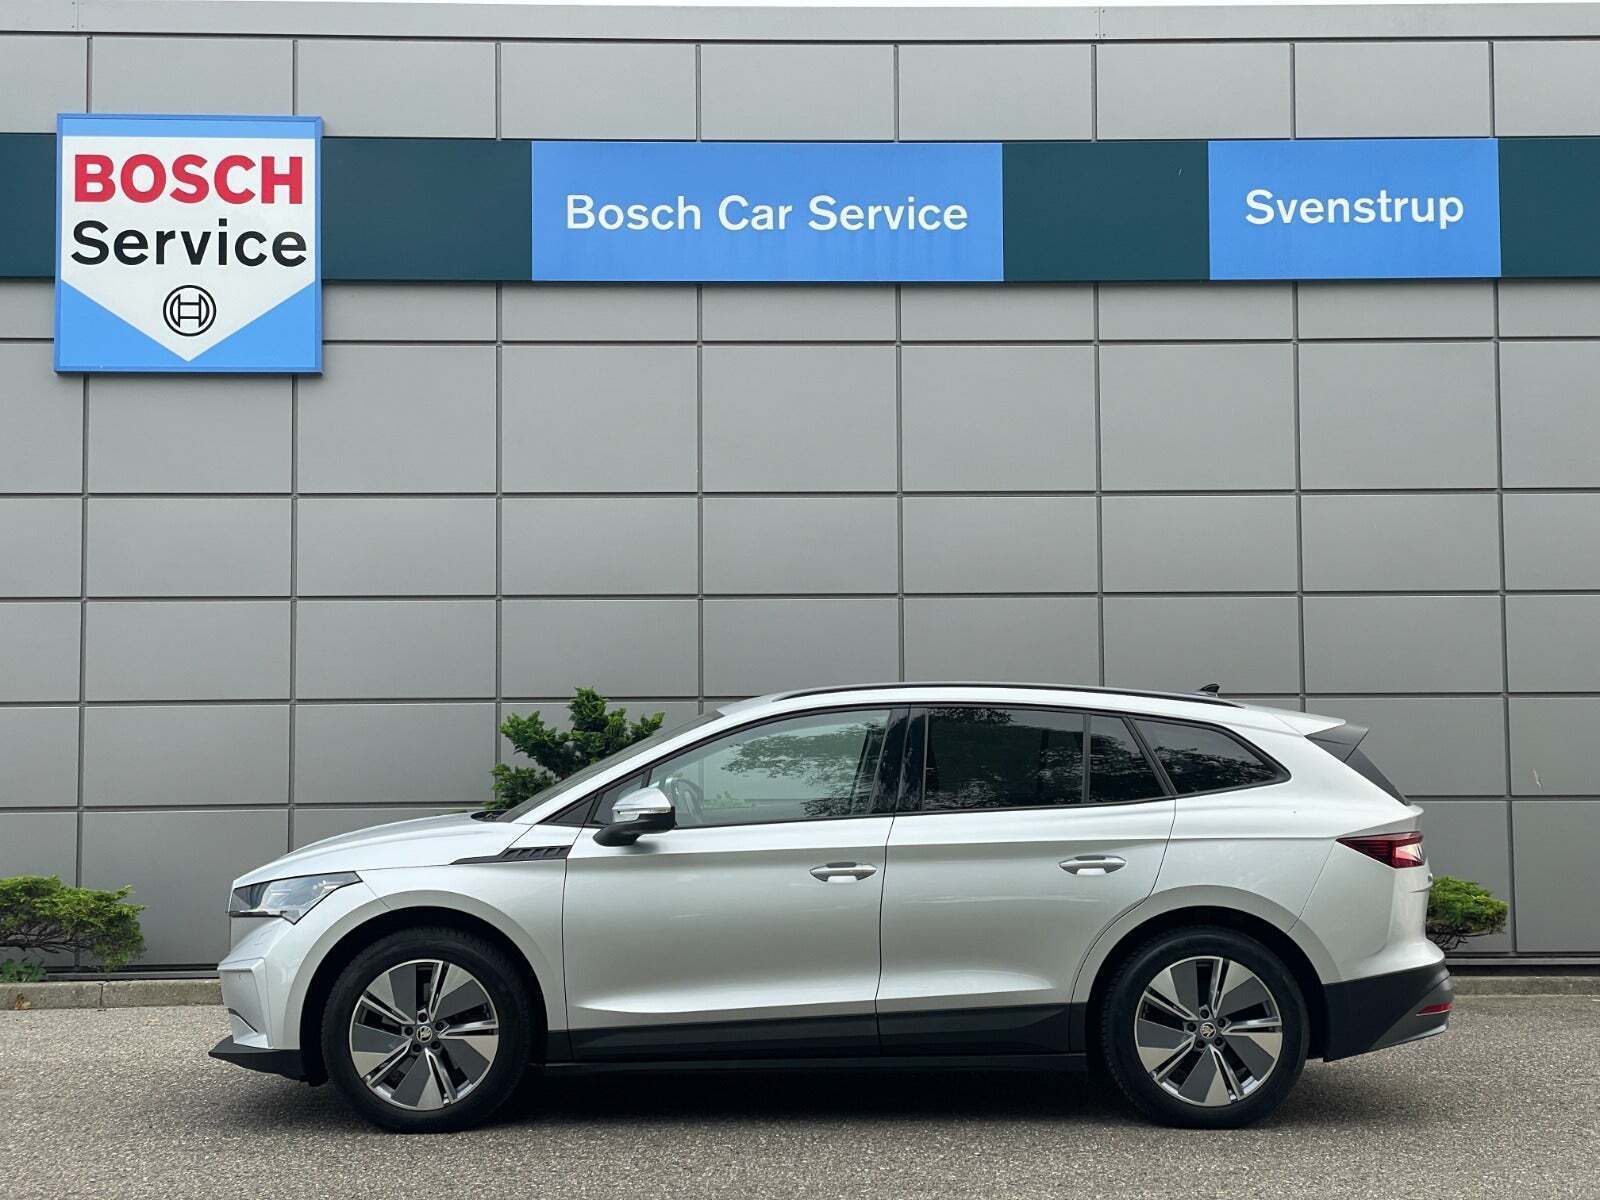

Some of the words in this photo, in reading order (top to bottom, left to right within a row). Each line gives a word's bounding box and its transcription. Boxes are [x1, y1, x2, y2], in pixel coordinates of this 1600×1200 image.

[75, 155, 302, 204] BOSCH
[568, 195, 700, 229] Bosch
[719, 195, 792, 230] Car
[809, 195, 967, 230] Service
[1246, 190, 1463, 229] Svenstrup
[72, 219, 306, 267] Service
